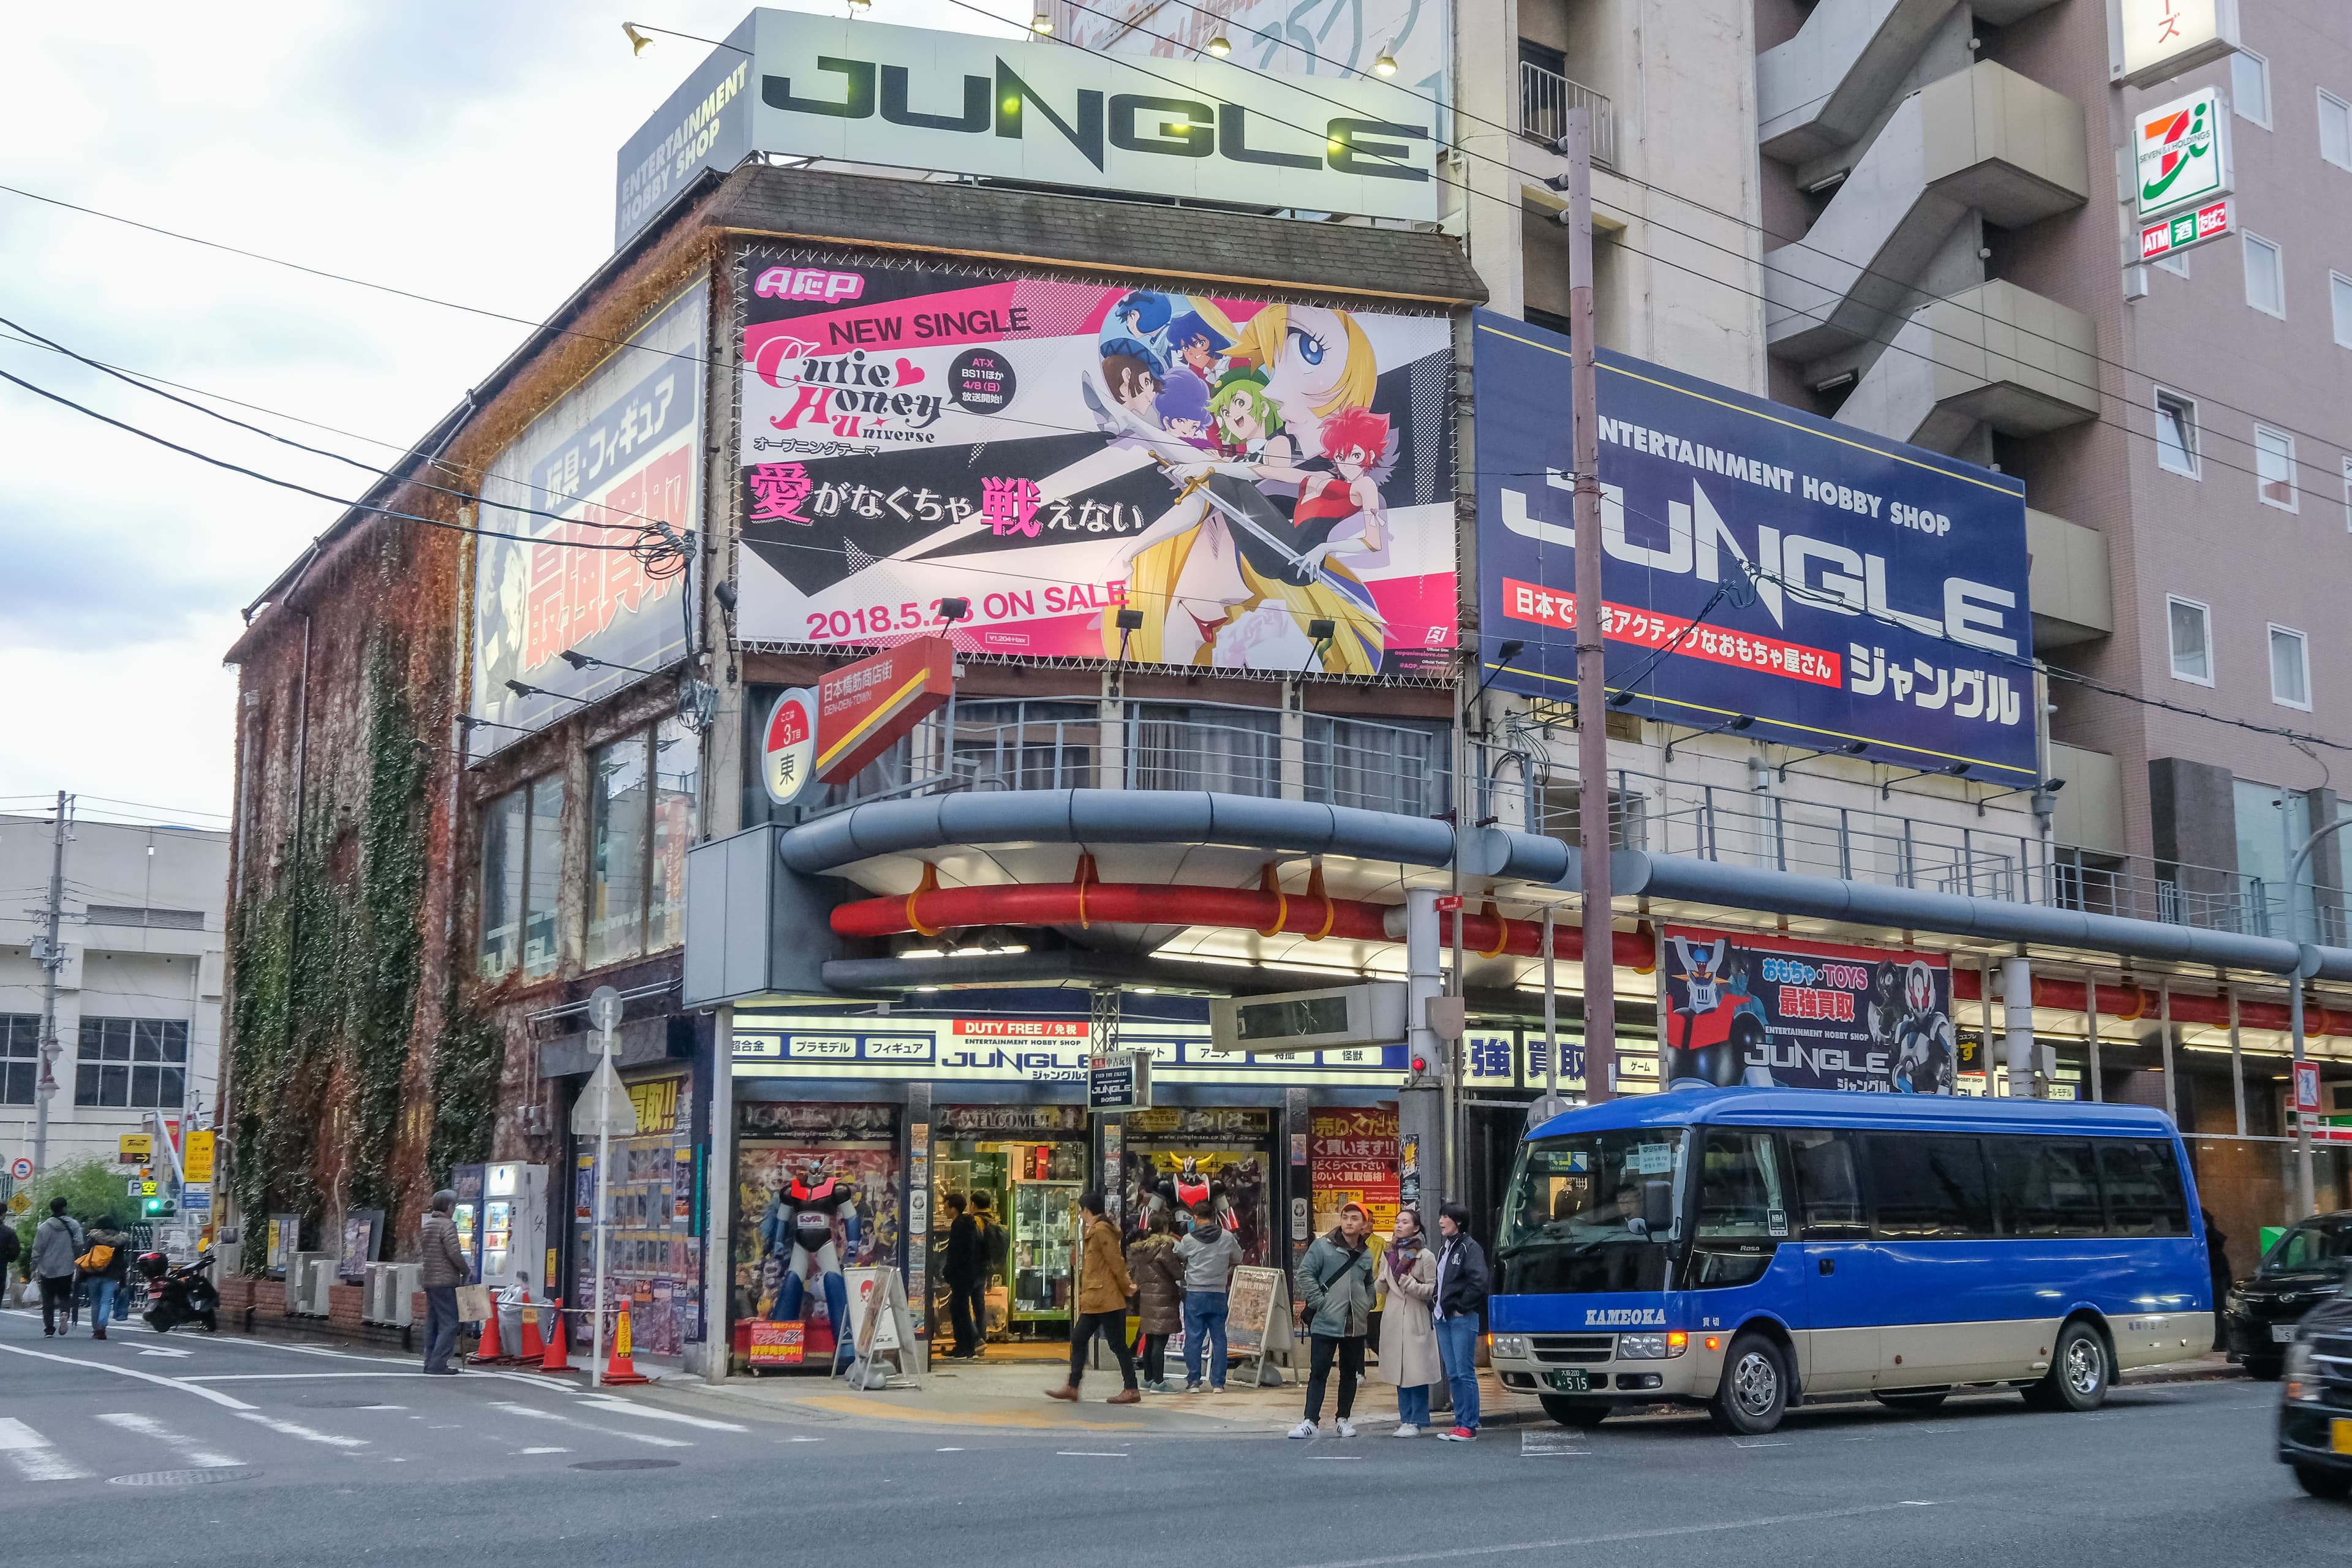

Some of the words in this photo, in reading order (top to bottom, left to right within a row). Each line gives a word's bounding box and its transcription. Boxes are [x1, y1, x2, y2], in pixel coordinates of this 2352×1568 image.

[762, 55, 1428, 182] JUNGLE
[622, 59, 747, 203] ENTERTAINMENT
[2172, 130, 2211, 151] HOLDINGS
[622, 167, 670, 231] HOBBY
[676, 118, 720, 176] SHOP
[2174, 219, 2193, 243] 酒
[2199, 208, 2225, 232] たばこ
[2144, 228, 2168, 252] ATM
[829, 316, 902, 345] NEW
[914, 307, 1031, 339] SINGLE
[755, 336, 891, 388] Cutie
[961, 368, 1004, 380] BS11ほか
[972, 358, 994, 368] AT-X
[770, 386, 943, 431] Honey
[962, 391, 1003, 404] 放送開始!
[753, 437, 880, 458] オープニングテーマ
[1596, 415, 1795, 494] NTERTAINMENT
[1801, 475, 1882, 520] HOBBY
[1890, 501, 1951, 538] SHOP
[750, 462, 1144, 539] 愛がなくちゃ戦えない
[1501, 467, 2018, 656] JUNGLE
[982, 589, 1034, 620] ON
[1045, 579, 1130, 614] SALE
[823, 658, 893, 704] 日本橋筋商店街
[1849, 641, 2021, 726] ジャングル
[780, 710, 795, 722] ここは
[824, 693, 872, 717] DEN-DEN-TOWN
[783, 723, 801, 745] 3丁目
[780, 753, 795, 785] 東
[1778, 986, 1855, 1023] 最強買取
[965, 1022, 1005, 1035] DUTY
[1007, 1023, 1042, 1035] FREE
[1055, 1023, 1077, 1035] 免税
[1765, 1025, 1823, 1039] ENTERTAINMENT
[1824, 1030, 1849, 1041] HOBBY
[1850, 1032, 1869, 1042] SHOP
[796, 1041, 851, 1054] プラモデル
[872, 1042, 924, 1055] フィギュア
[1342, 1050, 1363, 1061] 怪獣
[1744, 1038, 1890, 1079] JUNGLE
[941, 1047, 1088, 1074] JUNGLE
[1630, 1061, 1651, 1072] ゲーム
[1091, 1084, 1132, 1095] JUNGLE
[1836, 1077, 1890, 1094] ジャングル
[141, 1182, 157, 1196] 空
[1585, 1308, 1666, 1325] KAMEOKA
[1702, 1317, 1720, 1328] 貸切
